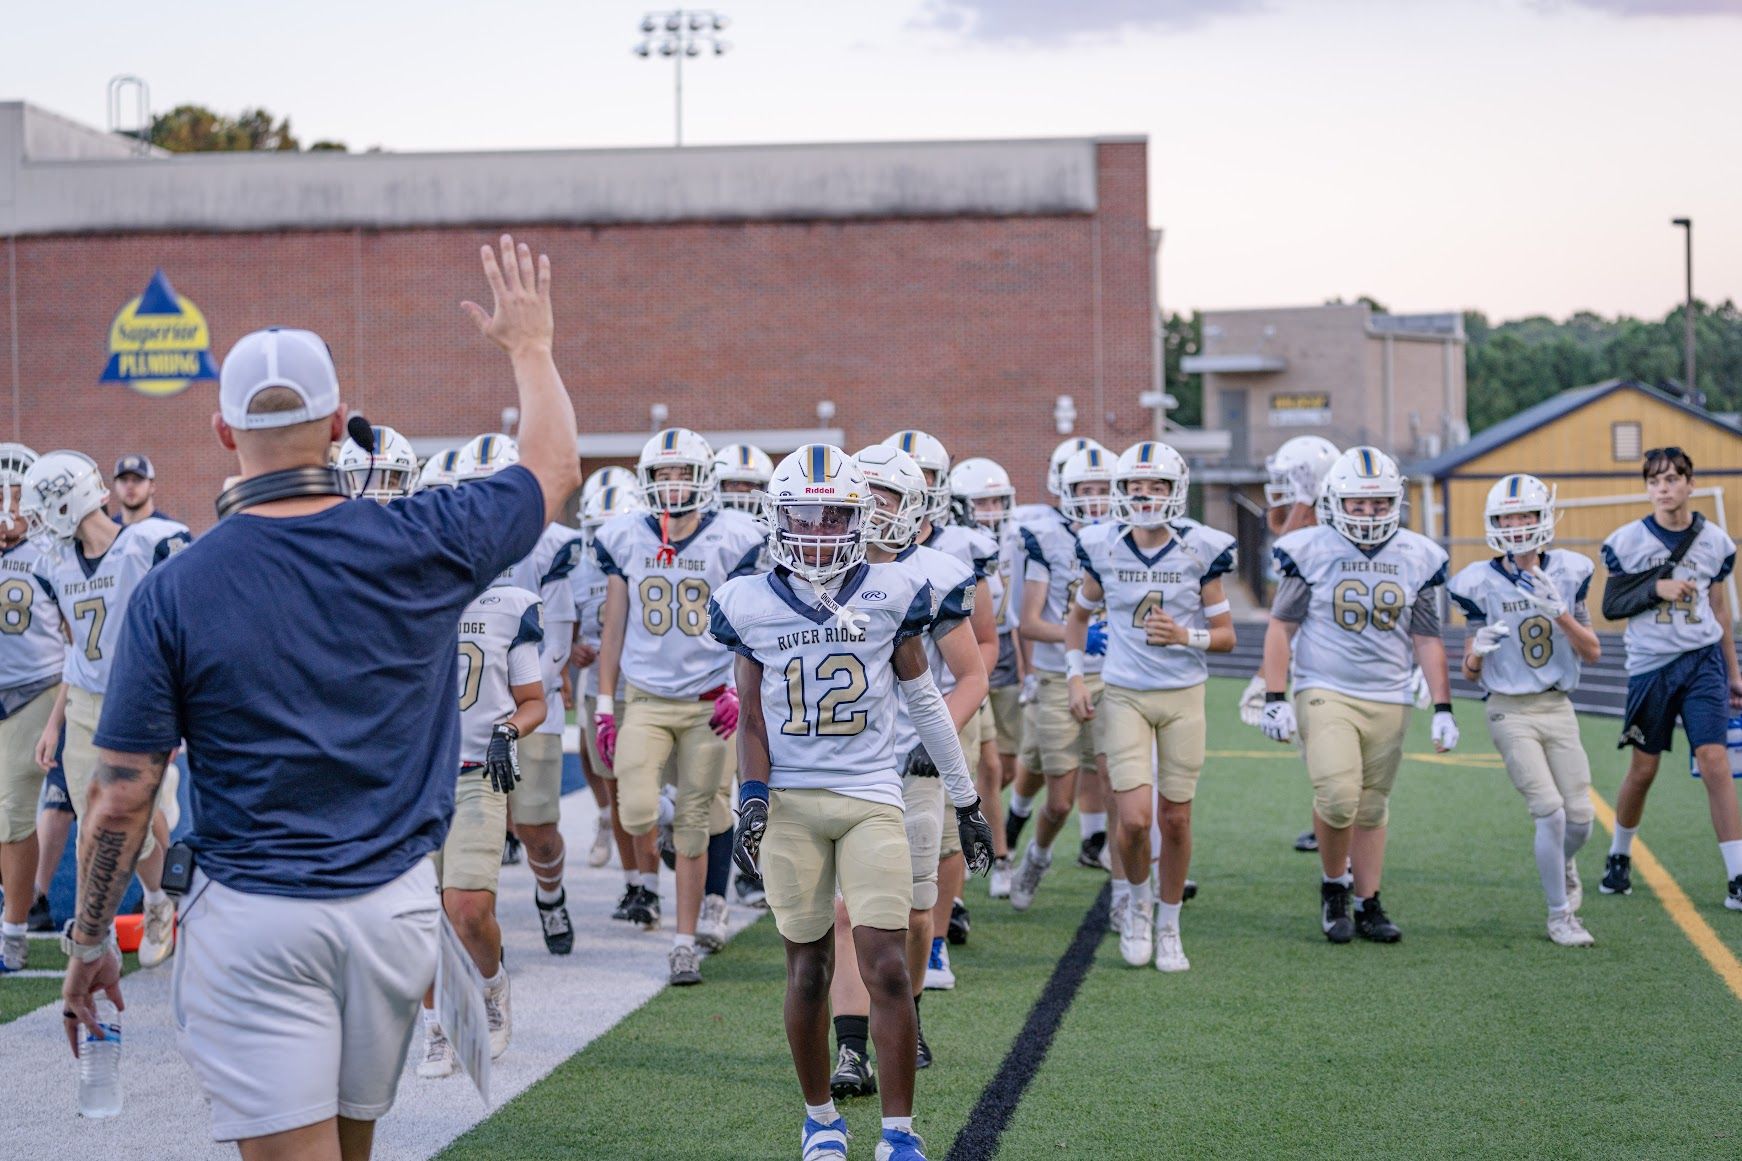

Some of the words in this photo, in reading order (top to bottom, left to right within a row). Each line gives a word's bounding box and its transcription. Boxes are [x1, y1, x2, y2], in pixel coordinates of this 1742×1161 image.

[1, 559, 32, 573] RIDGE
[678, 559, 706, 571] RIDGE
[1118, 569, 1148, 582] RIVER
[1151, 571, 1182, 583] RIDGE
[1341, 561, 1370, 573] RIVER
[1373, 562, 1399, 576] RIDGE
[638, 575, 711, 637] 88
[1332, 578, 1406, 634] 68
[1502, 599, 1531, 613] RIVER
[74, 596, 107, 662] 7
[458, 622, 486, 634] IDGE
[1132, 590, 1167, 647] 4
[777, 629, 820, 651] RIVER
[825, 627, 866, 642] RIDGE
[1519, 614, 1554, 670] 8
[781, 652, 870, 737] 12
